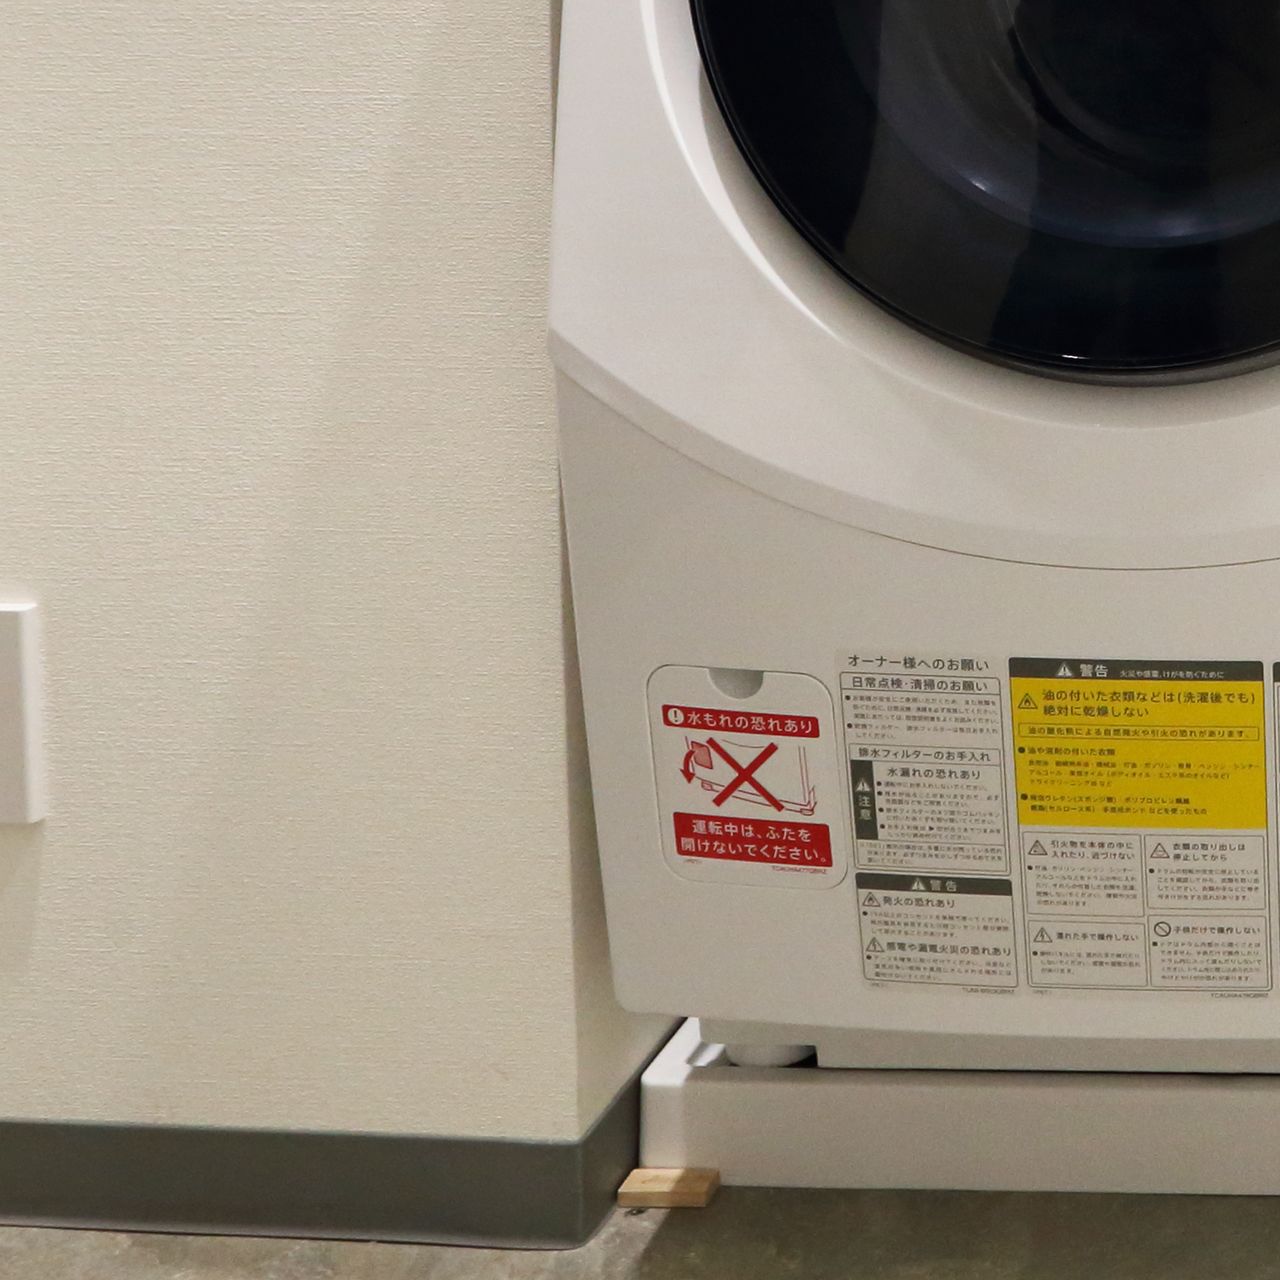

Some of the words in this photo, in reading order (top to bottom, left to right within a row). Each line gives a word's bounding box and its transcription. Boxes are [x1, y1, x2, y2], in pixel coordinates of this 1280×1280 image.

[847, 654, 990, 672] オーナー様へのお願い
[1079, 663, 1109, 679] 警告
[852, 676, 989, 693] 日常点検・清掃のお願い
[1043, 705, 1150, 718] 絶対に乾燥しない
[686, 711, 813, 734] 水もれの恐れあり
[858, 747, 992, 763] 排水フィルターのお手入れ
[887, 767, 982, 780] 水漏れの恐れあり
[691, 819, 812, 843] 運転中は、ふたを
[680, 837, 827, 863] 開けないでください。
[1173, 853, 1229, 863] 停止してから
[882, 895, 956, 909] 発火の恐れあり
